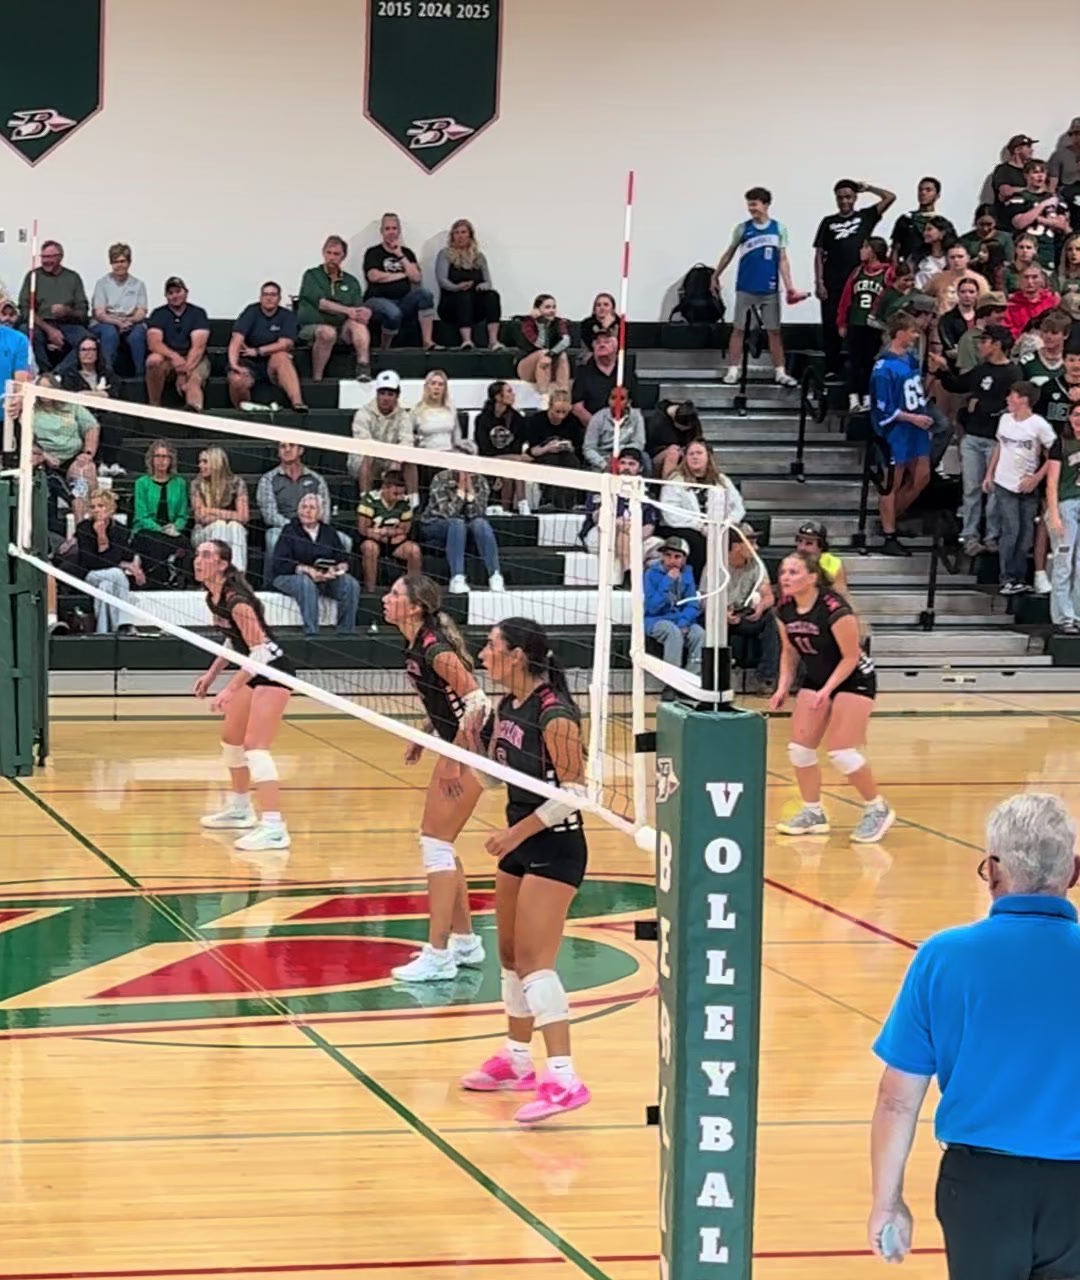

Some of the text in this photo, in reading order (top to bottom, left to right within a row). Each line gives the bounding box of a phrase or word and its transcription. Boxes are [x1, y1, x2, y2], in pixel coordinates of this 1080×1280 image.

[377, 1, 491, 19] 2015 2024 2025
